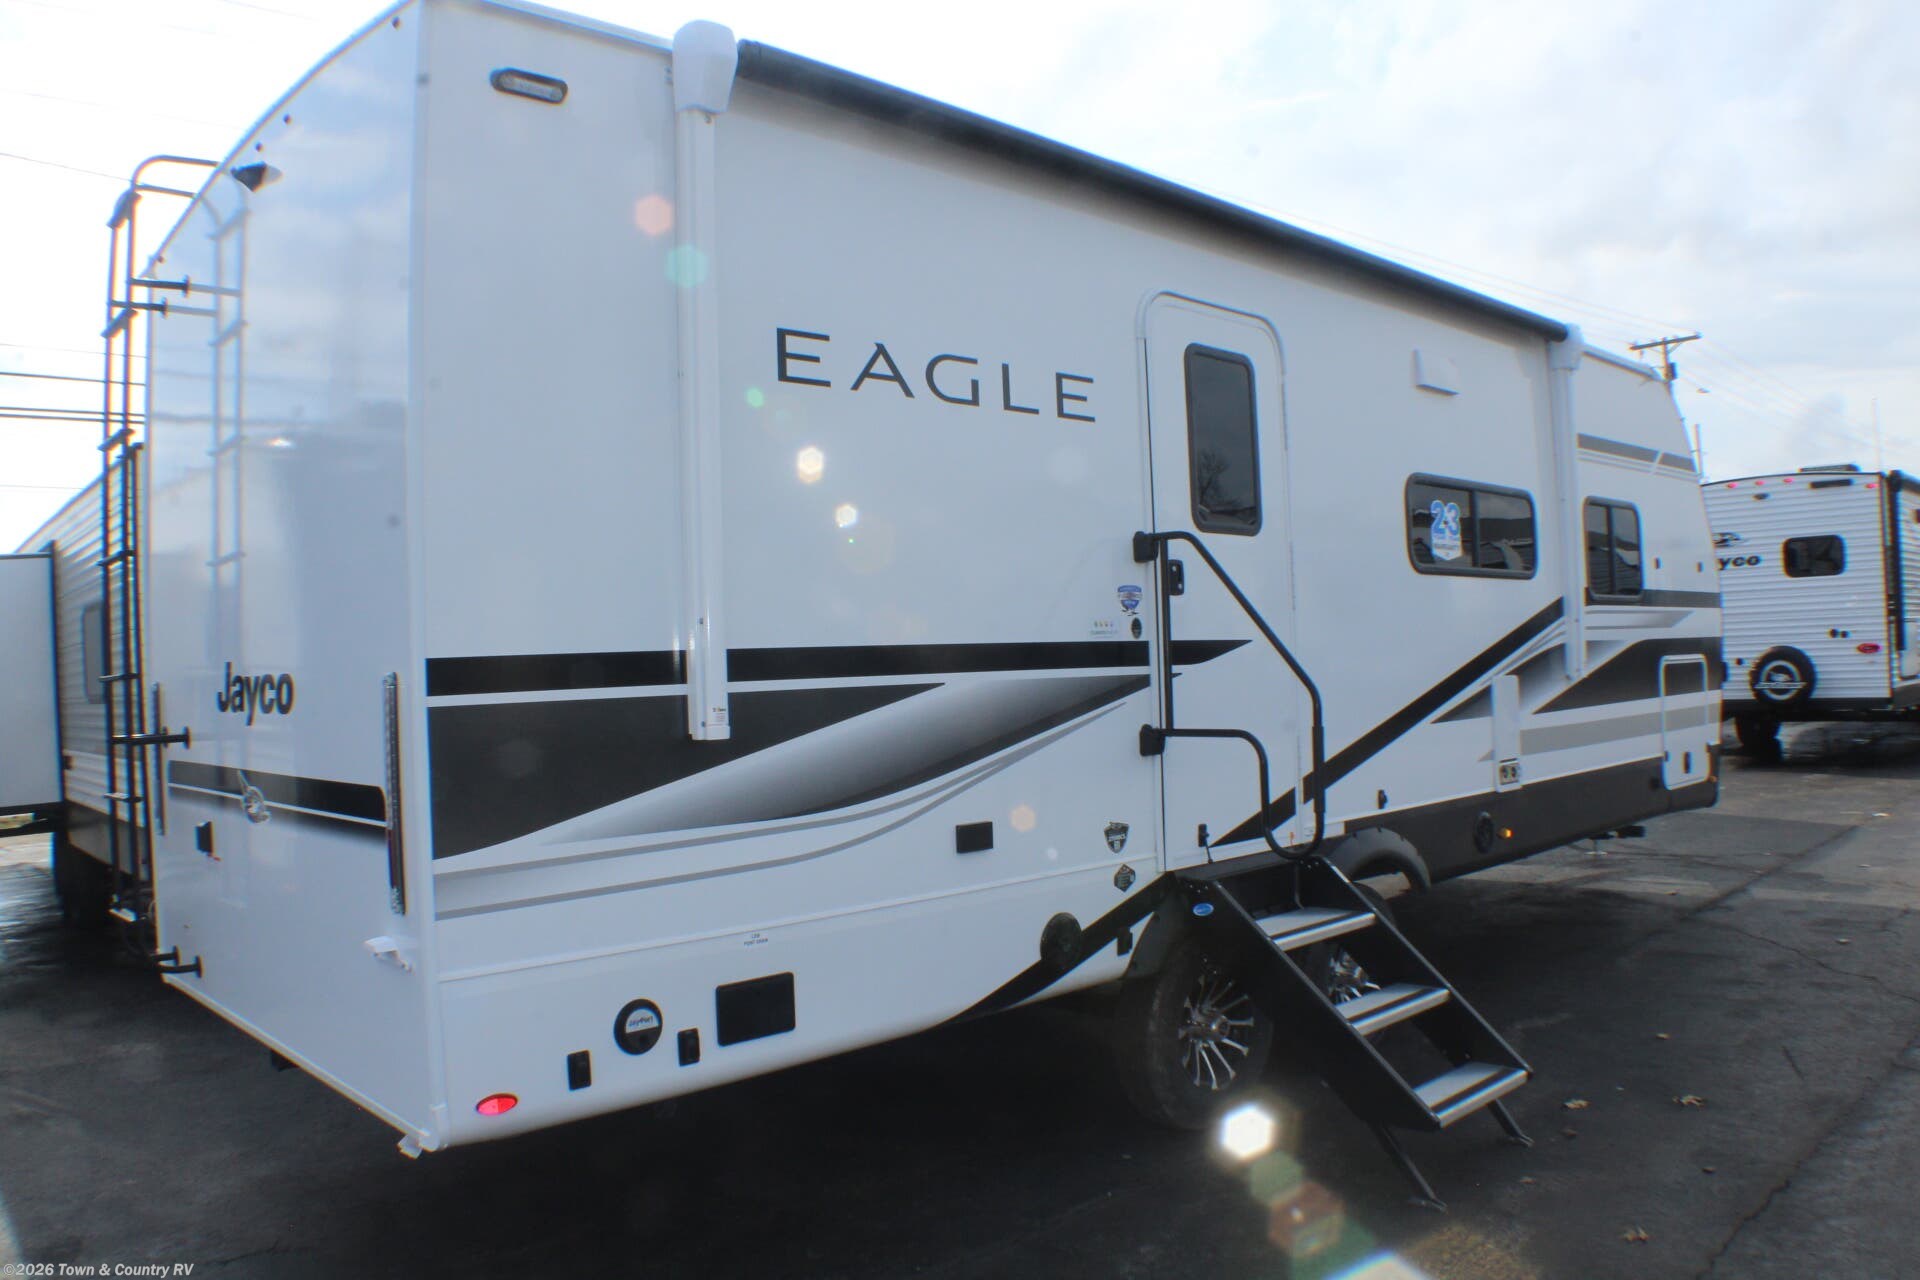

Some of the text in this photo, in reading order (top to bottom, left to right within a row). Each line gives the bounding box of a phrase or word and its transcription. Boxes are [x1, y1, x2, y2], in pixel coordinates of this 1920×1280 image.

[776, 327, 1096, 423] EAGLE
[1718, 555, 1761, 571] yco
[217, 661, 295, 727] Jayco
